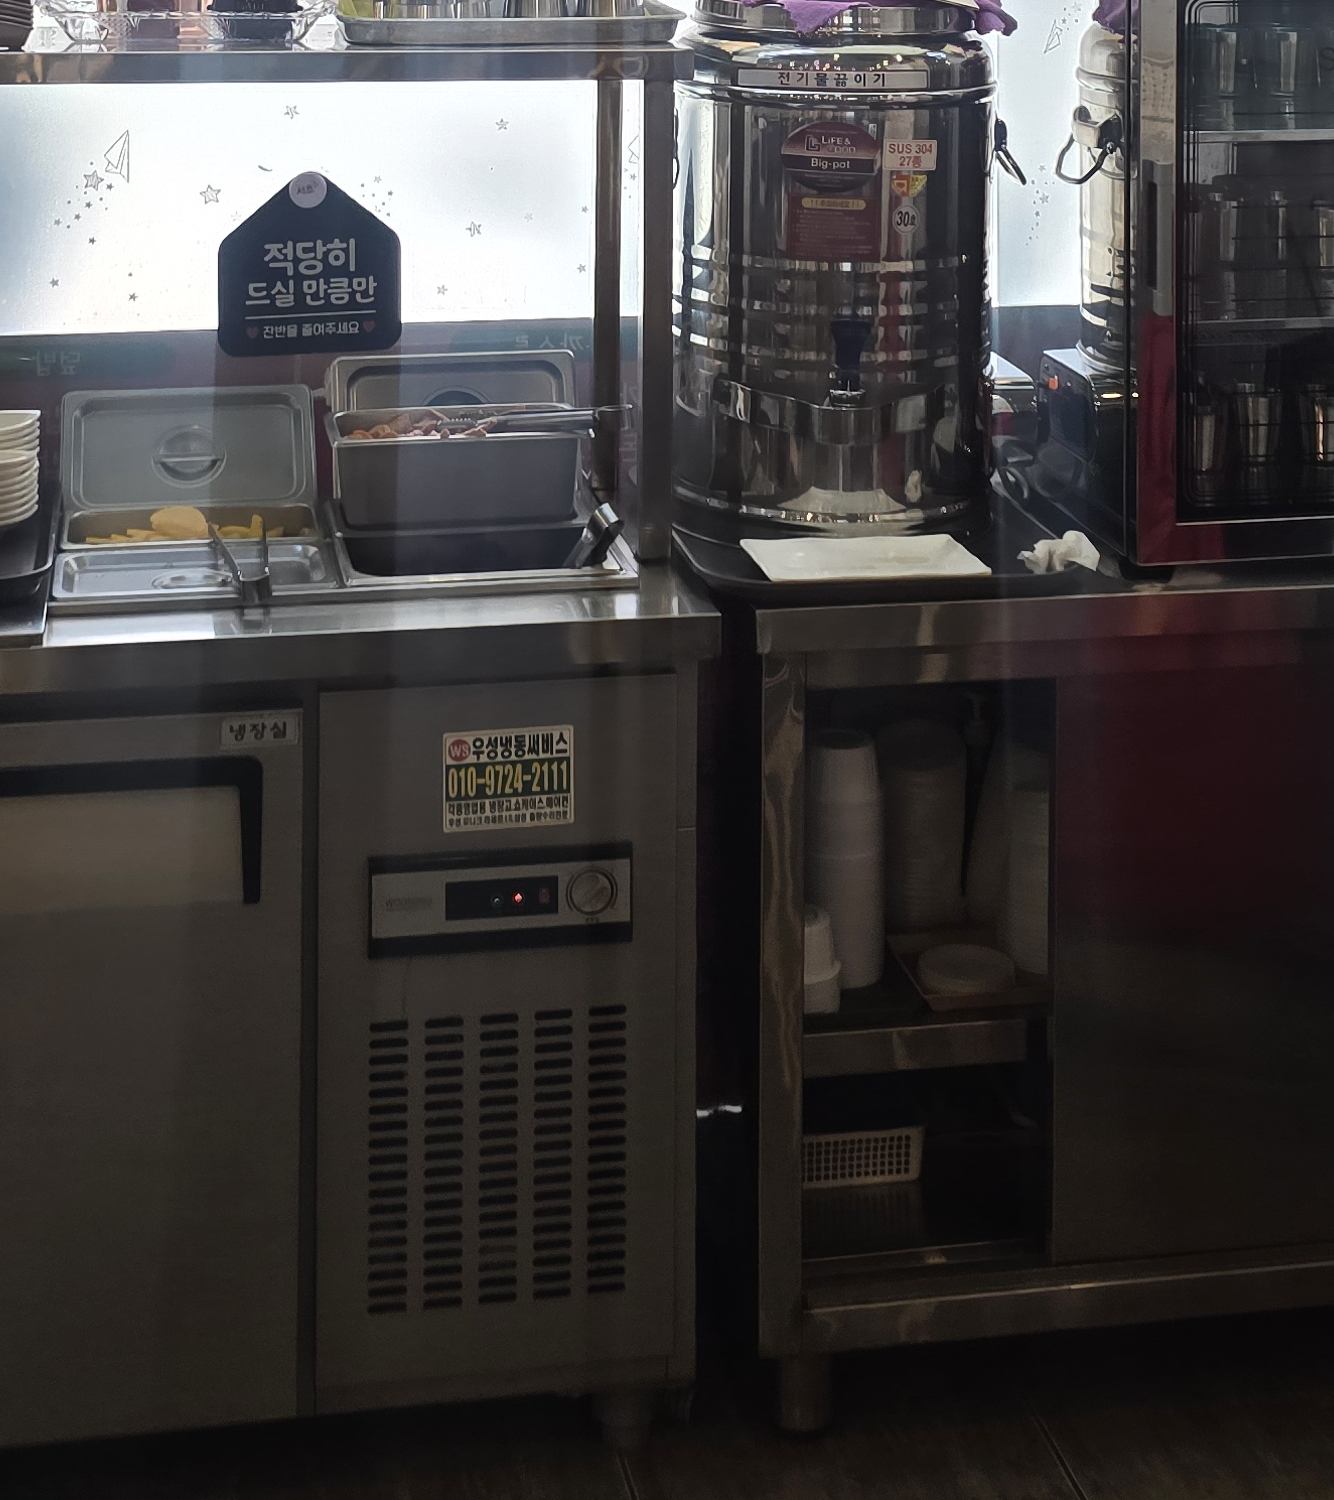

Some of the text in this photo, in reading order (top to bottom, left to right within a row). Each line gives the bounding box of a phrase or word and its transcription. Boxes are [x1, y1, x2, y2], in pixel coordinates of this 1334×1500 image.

[778, 71, 886, 88] 전기물끓이기
[888, 143, 933, 155] SUS 304
[811, 158, 850, 169] Big-pot
[264, 238, 355, 276] 적당히
[246, 275, 377, 307] 드실 만큼만
[230, 721, 286, 741] 냉장실
[450, 731, 568, 761] WS 우성냉동써비스
[448, 760, 567, 798] 010-9724-2111
